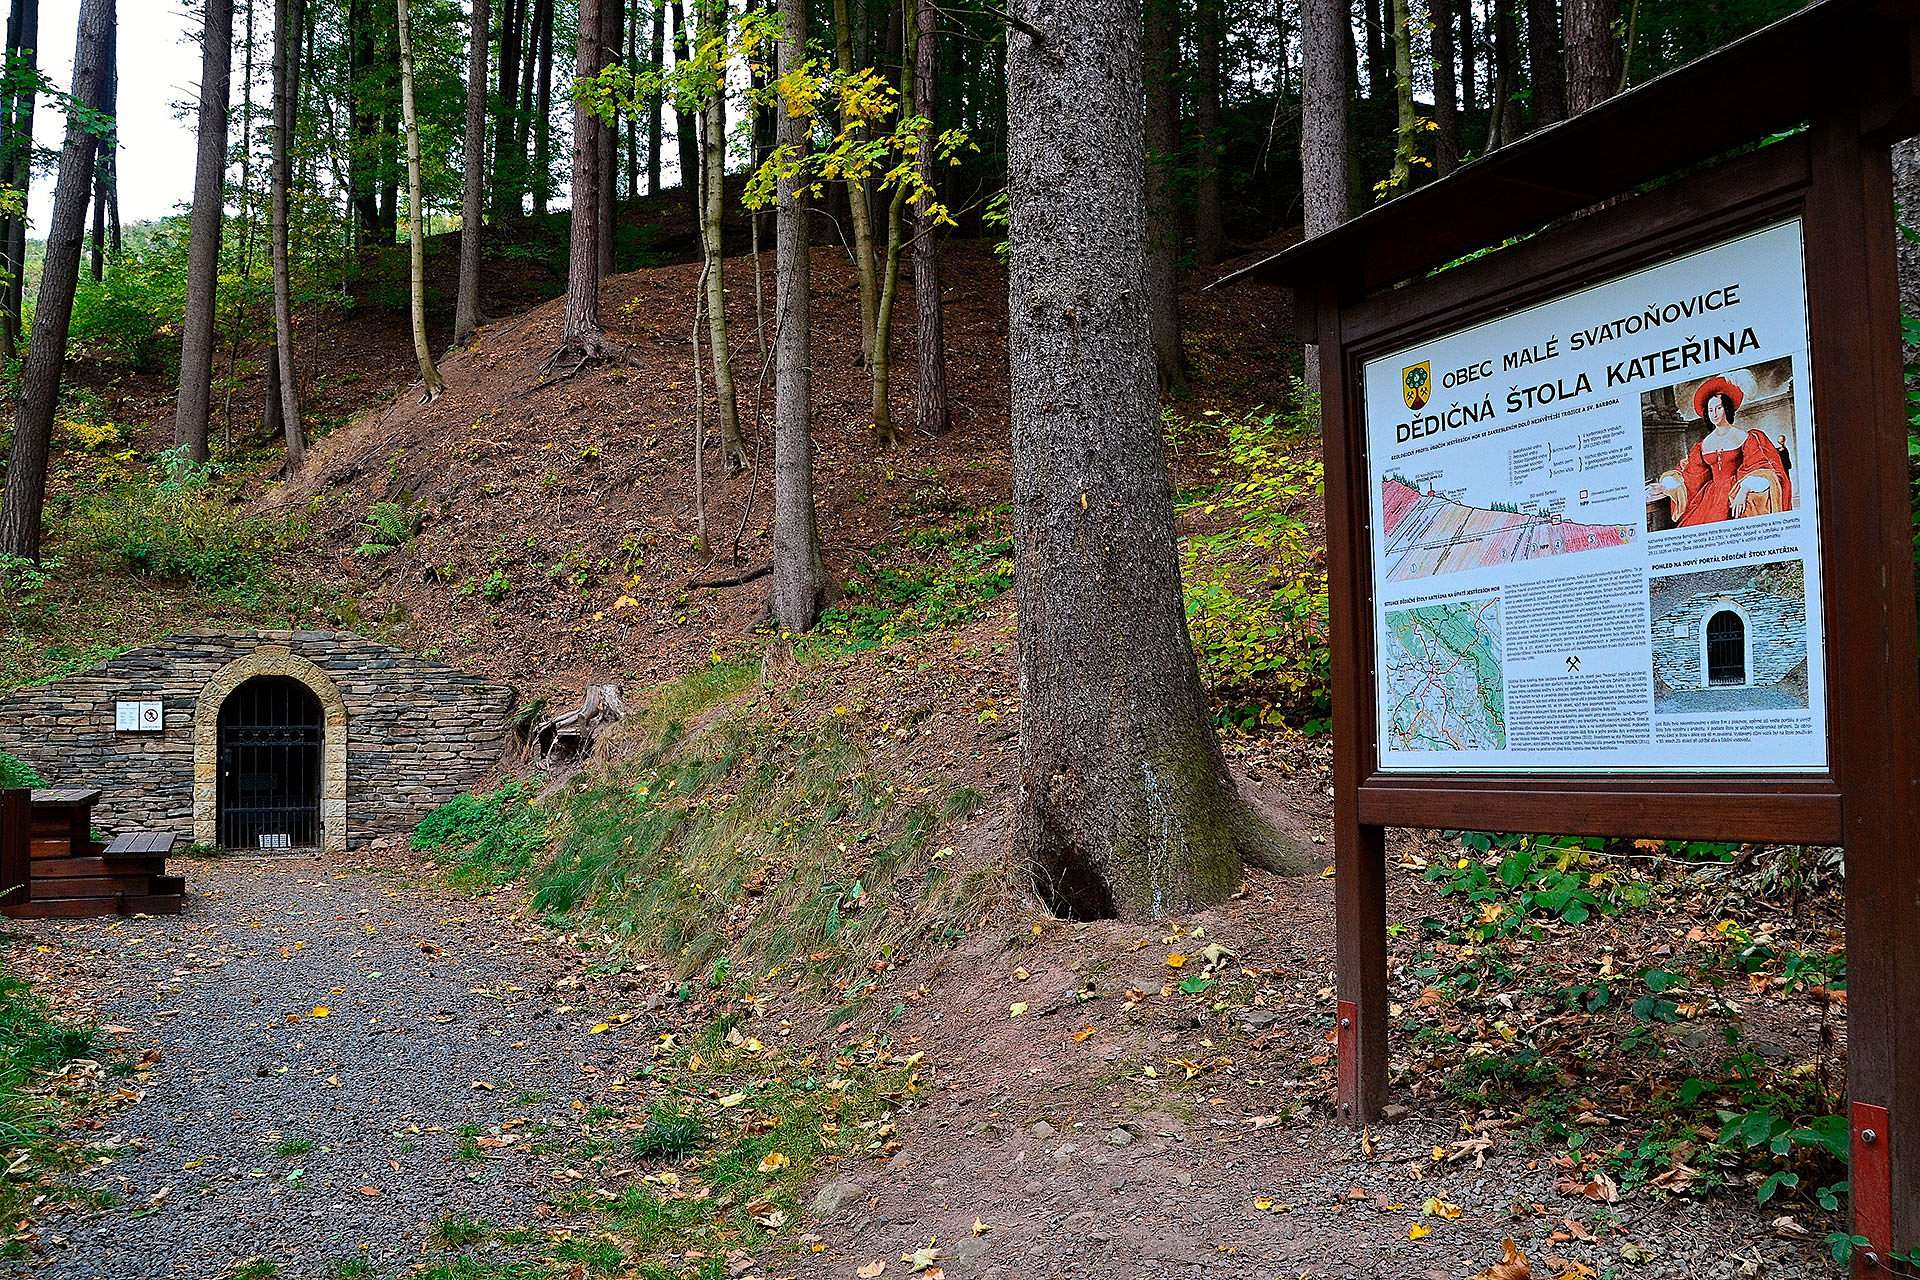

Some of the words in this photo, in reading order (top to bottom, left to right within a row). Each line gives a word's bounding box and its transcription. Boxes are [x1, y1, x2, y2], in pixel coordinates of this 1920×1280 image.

[1397, 393, 1495, 443] DĚDIČNÁ
[1507, 373, 1592, 413] ŠTOLA
[1607, 327, 1760, 387] KATEŘINA
[1443, 360, 1493, 388] OBEC
[1504, 335, 1559, 371] MALÉ
[1571, 284, 1740, 350] SVATOŇOVICE
[1683, 558, 1698, 566] NOVÝ
[1699, 555, 1720, 564] PORTÁL
[1721, 551, 1747, 561] DĚDIČNÉ
[1768, 546, 1798, 555] KATEŘINA
